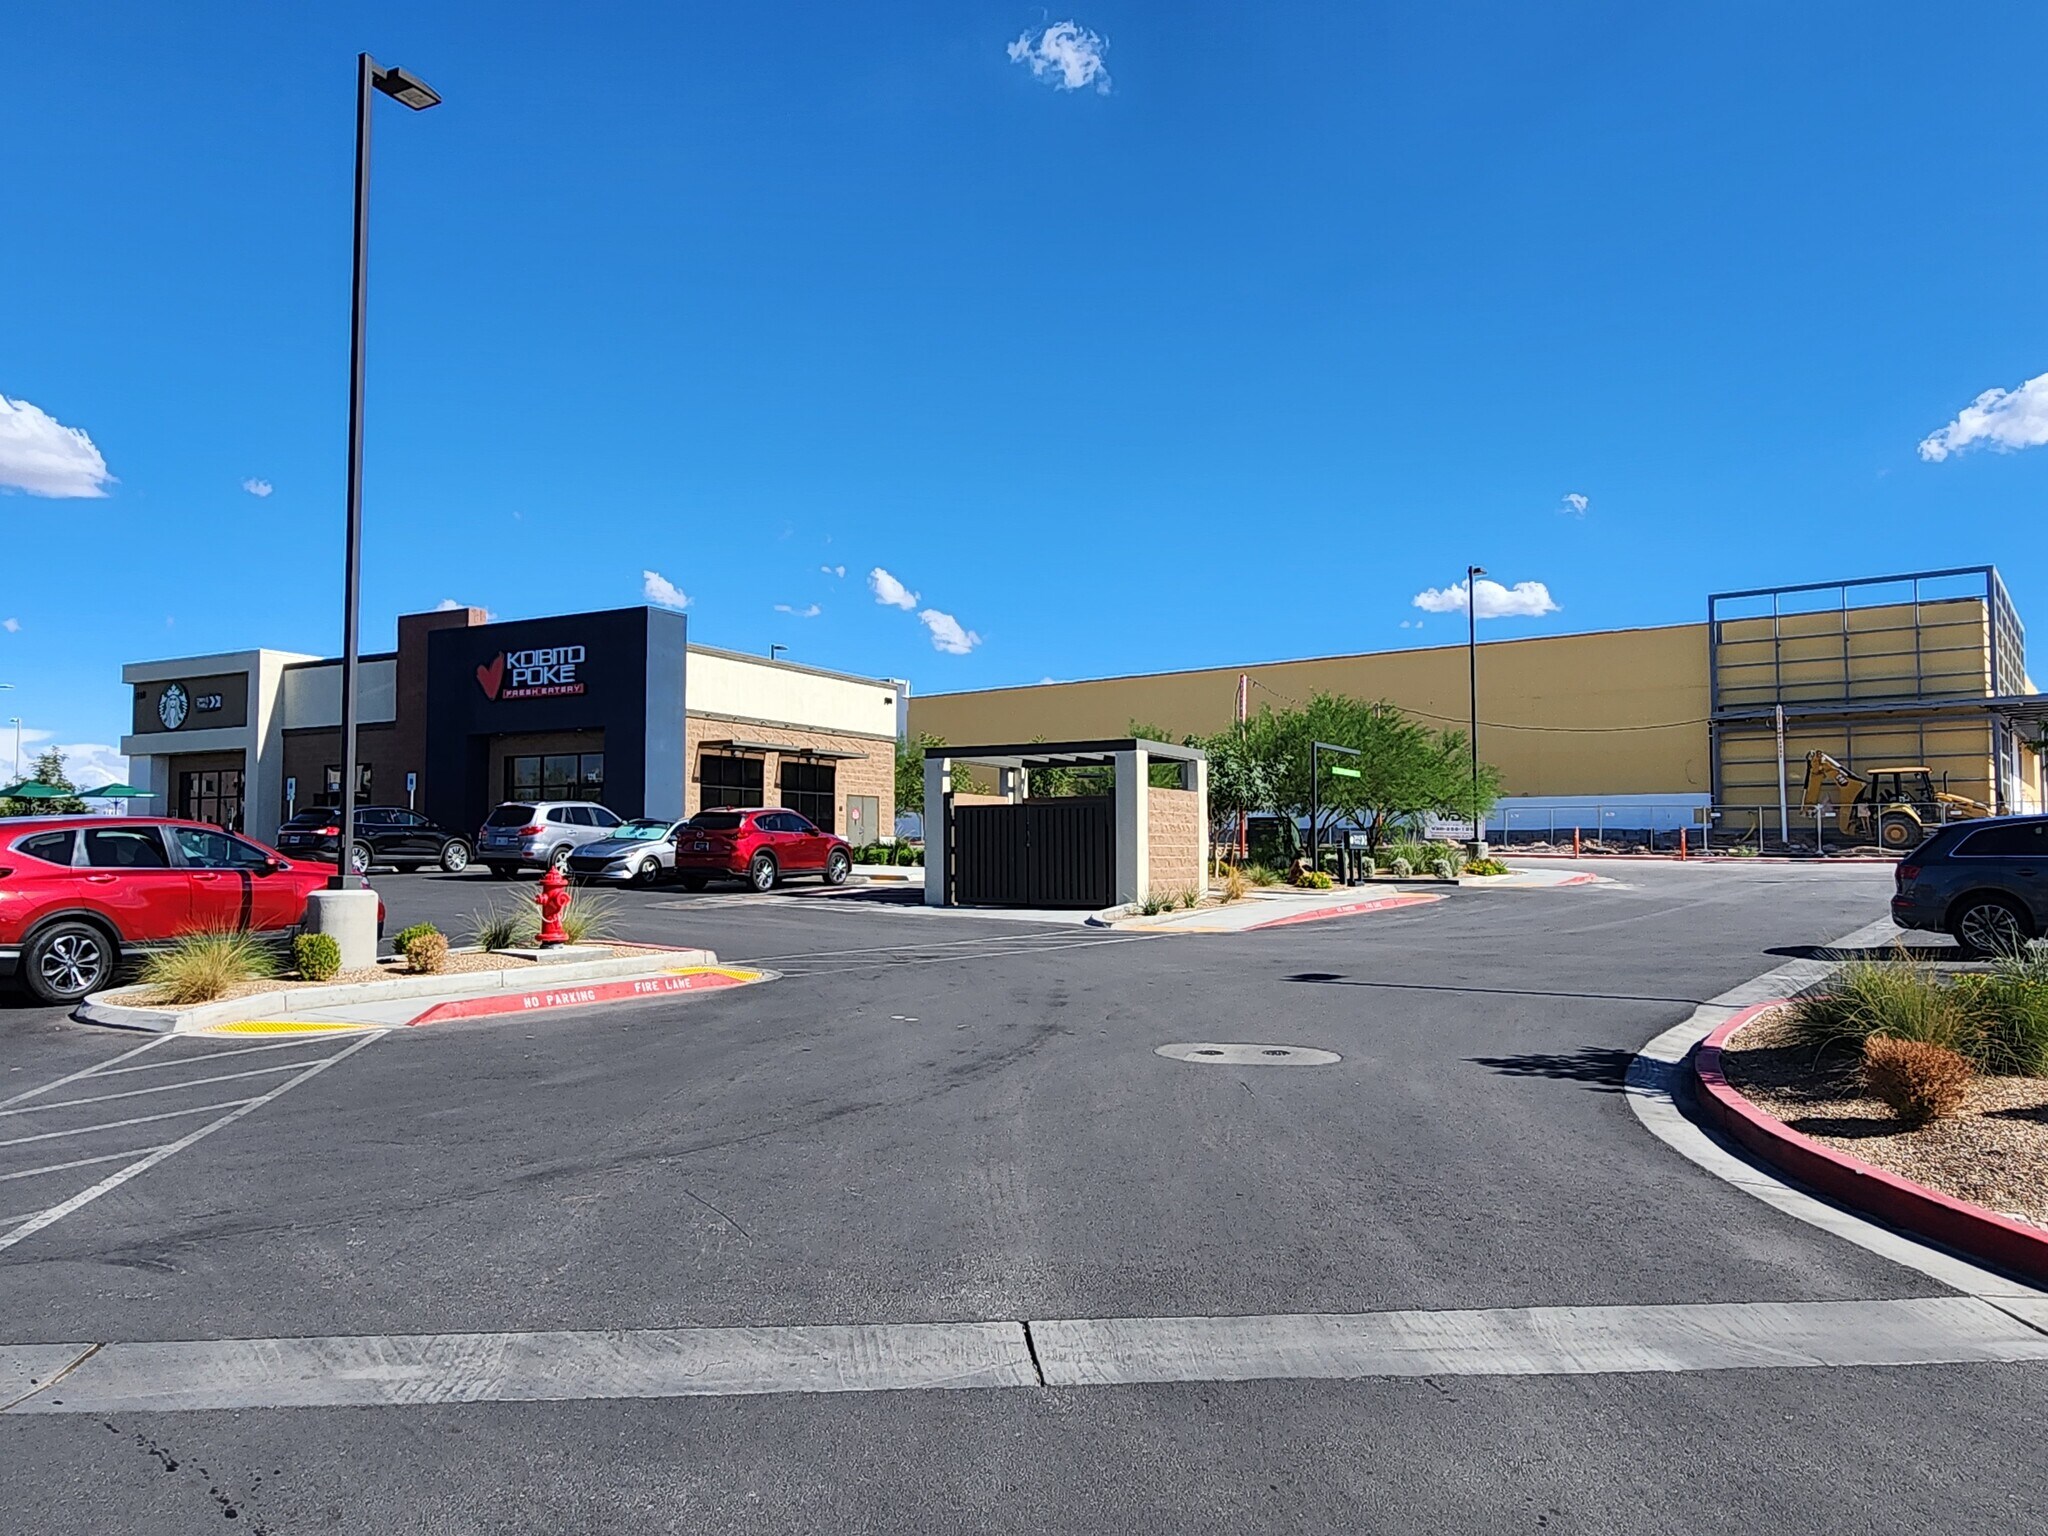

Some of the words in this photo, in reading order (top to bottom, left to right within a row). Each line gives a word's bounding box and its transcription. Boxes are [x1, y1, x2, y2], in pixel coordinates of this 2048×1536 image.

[507, 645, 585, 669] KOIBITO
[512, 664, 576, 687] POKE
[505, 687, 539, 698] FRESH
[541, 684, 582, 695] EATERY
[523, 997, 540, 1009] NO
[546, 990, 596, 1006] PARKING
[634, 981, 660, 993] FIRE
[665, 978, 692, 990] LANE
